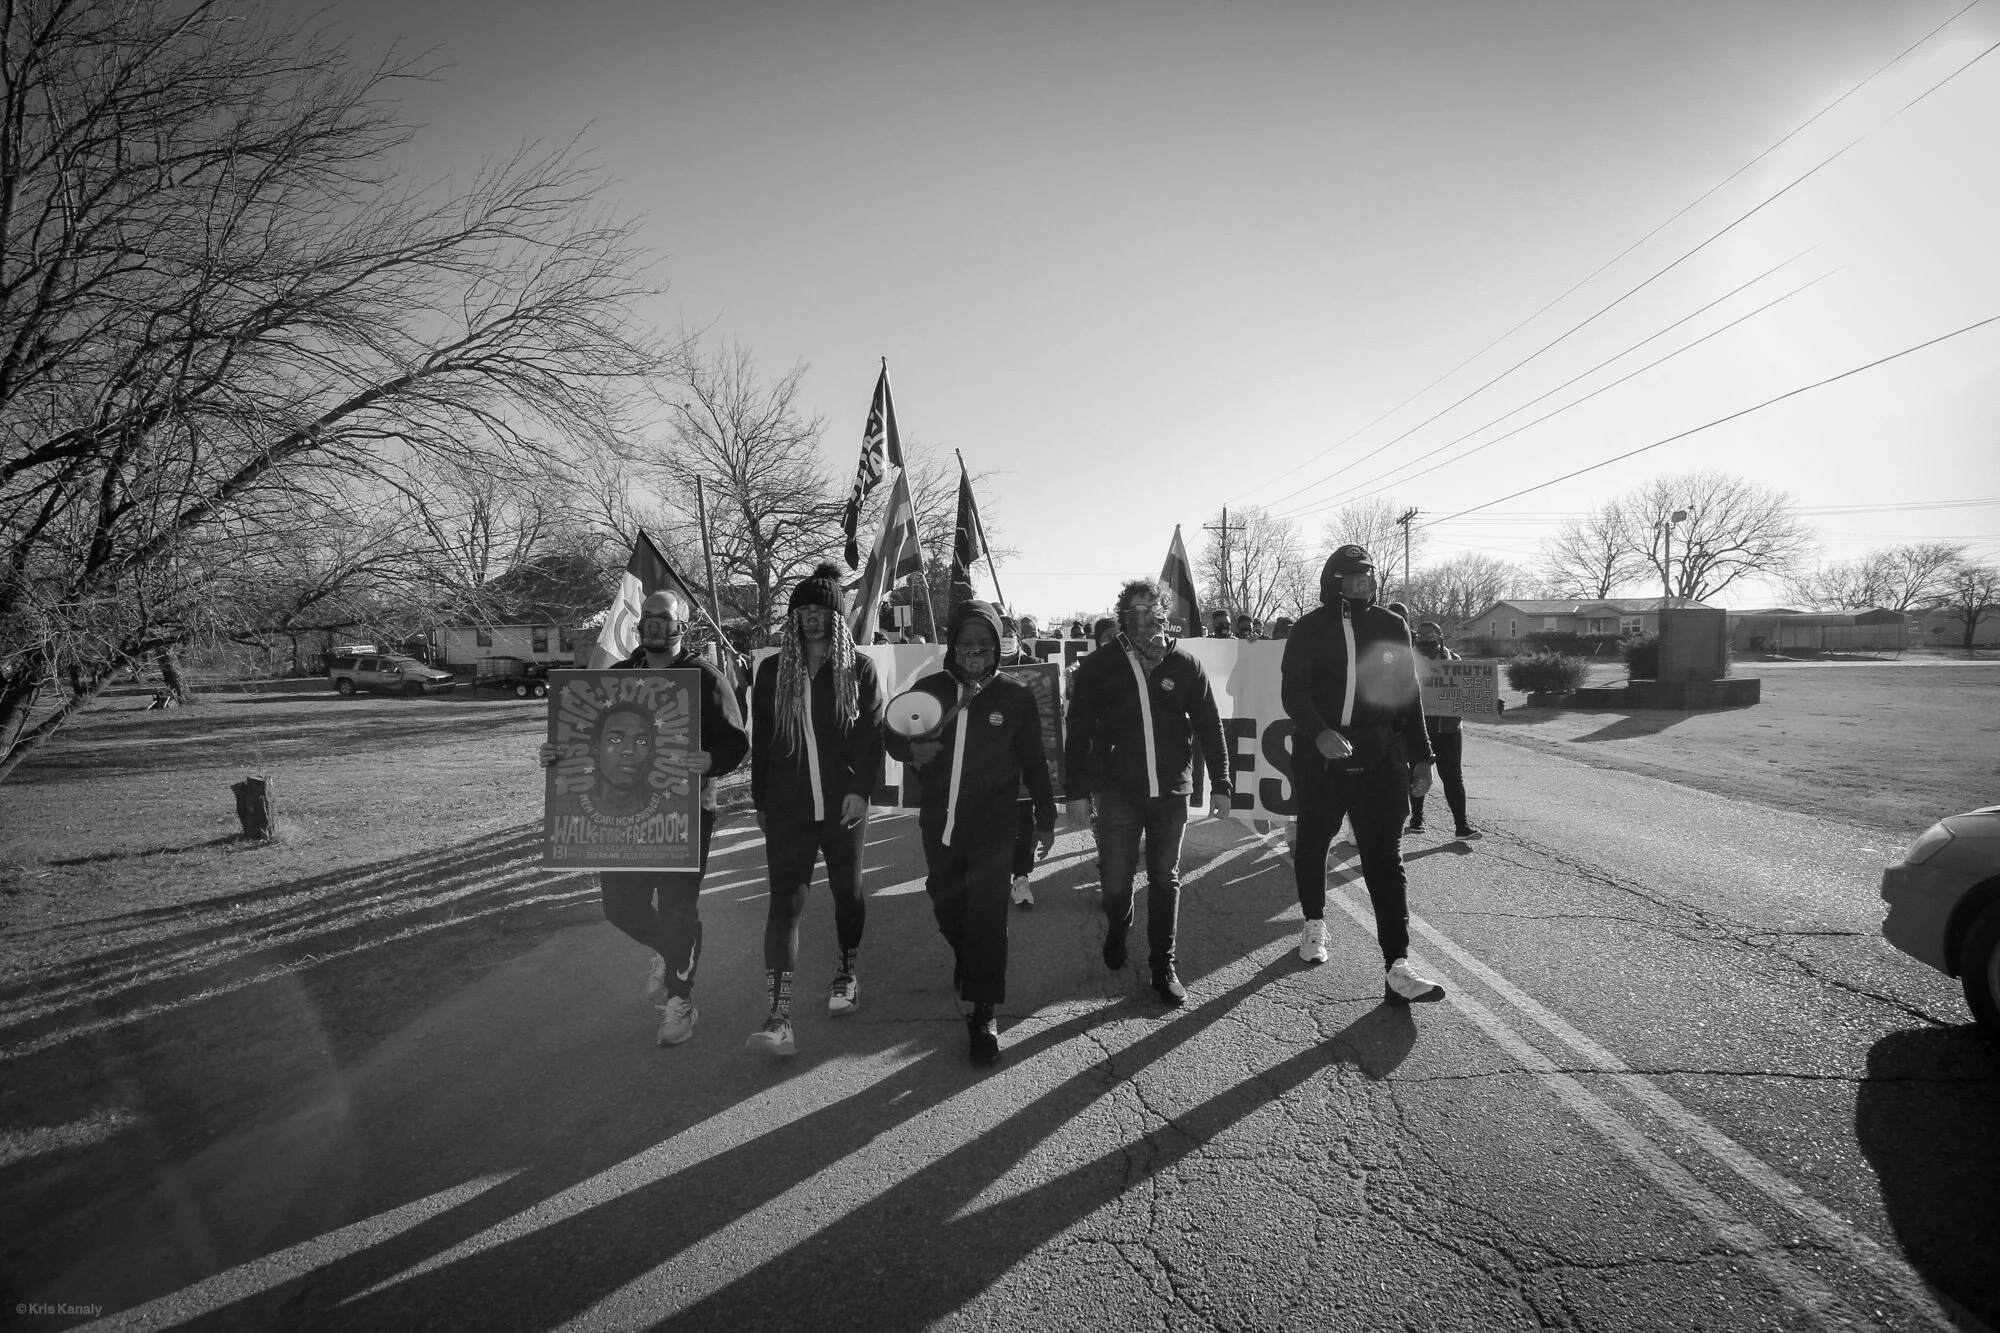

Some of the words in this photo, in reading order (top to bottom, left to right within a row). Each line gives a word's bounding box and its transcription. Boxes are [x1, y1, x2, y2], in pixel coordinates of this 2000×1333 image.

[1422, 676, 1459, 688] WILL
[1463, 676, 1493, 689] SET
[1441, 665, 1493, 677] TRUTH
[1438, 689, 1493, 701] JULIUS
[1453, 701, 1493, 713] FREE
[554, 678, 606, 796] JUSTICE
[601, 676, 668, 710] FOR
[648, 688, 690, 796] JULIUS
[1190, 718, 1297, 816] ES
[578, 793, 595, 813] NEW
[615, 815, 635, 826] NEW
[633, 792, 661, 824] JUSTICE!
[554, 814, 599, 845] WALK
[599, 826, 624, 844] FOR
[625, 812, 689, 845] FREEDOM
